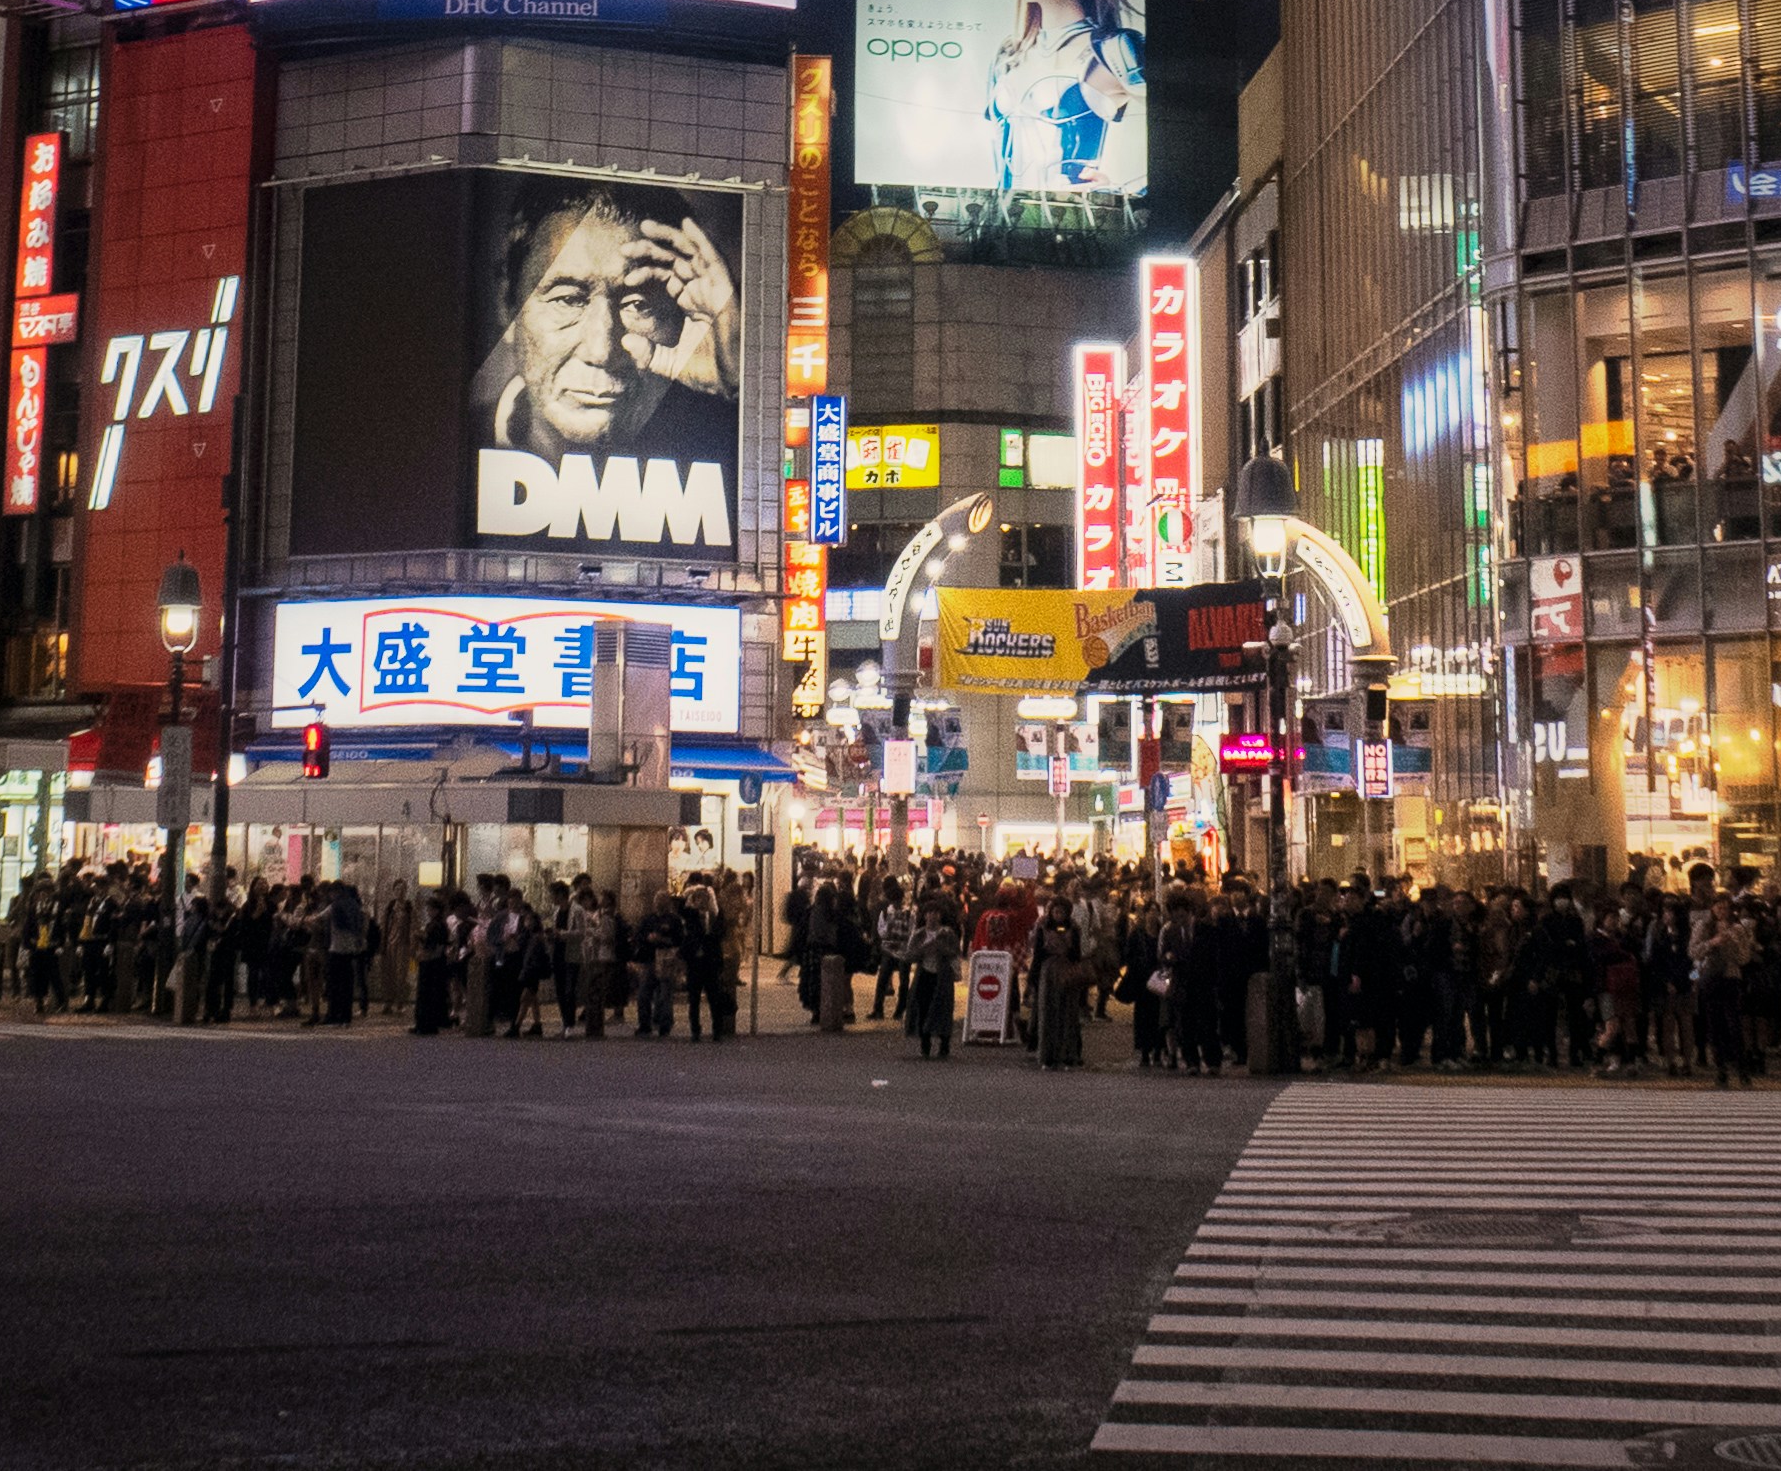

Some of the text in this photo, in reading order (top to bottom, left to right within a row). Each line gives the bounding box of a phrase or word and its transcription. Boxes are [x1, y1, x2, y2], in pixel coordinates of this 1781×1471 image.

[866, 37, 963, 63] oppo
[797, 67, 824, 278] クスリのことなら
[1085, 373, 1107, 467] BIG ECHO
[477, 448, 732, 546] DMM
[816, 403, 841, 539] 大盛堂商事ビル
[297, 622, 708, 701] 大盛堂書店
[679, 709, 723, 723] TAISEIDO
[1364, 743, 1388, 757] NO
